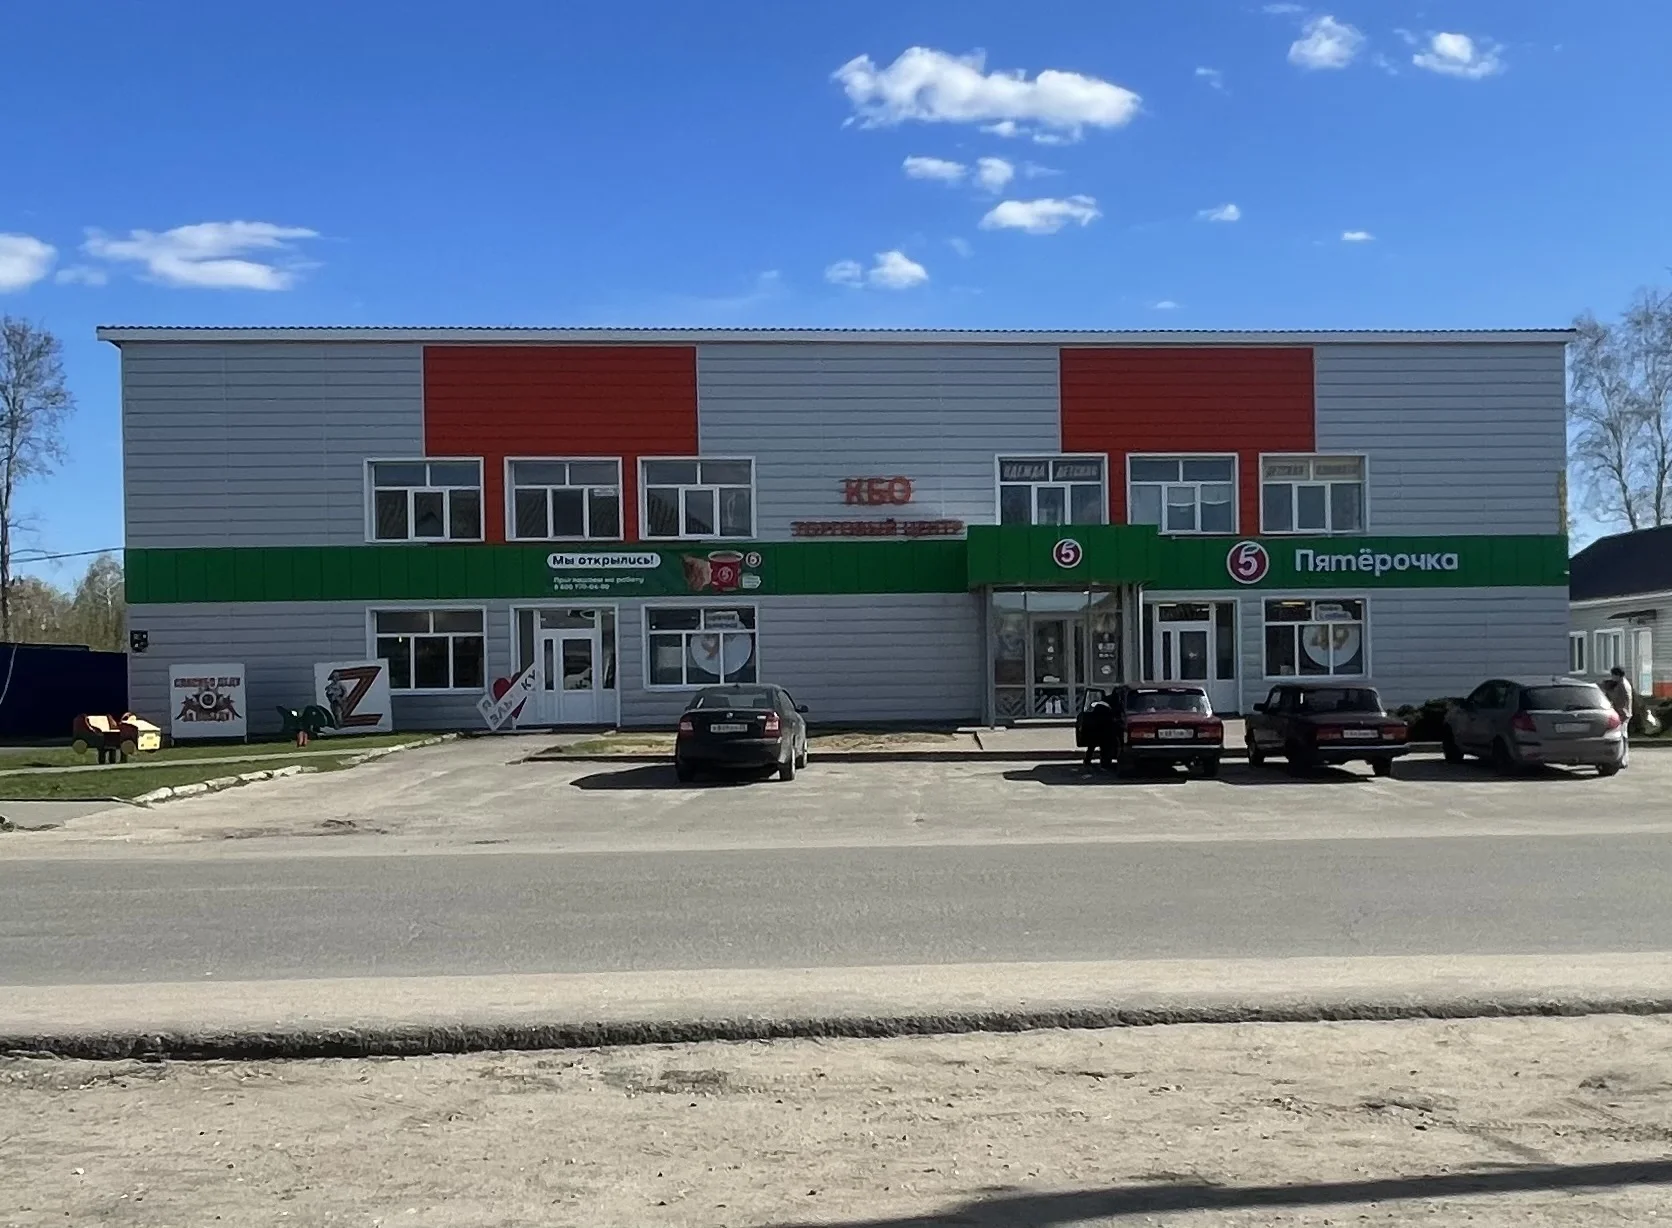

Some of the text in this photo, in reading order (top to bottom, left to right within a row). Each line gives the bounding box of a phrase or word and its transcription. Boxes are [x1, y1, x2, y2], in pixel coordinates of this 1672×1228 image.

[845, 476, 912, 505] КБО
[552, 555, 654, 567] Мы открылись!
[1295, 548, 1459, 577] Пятёрочка
